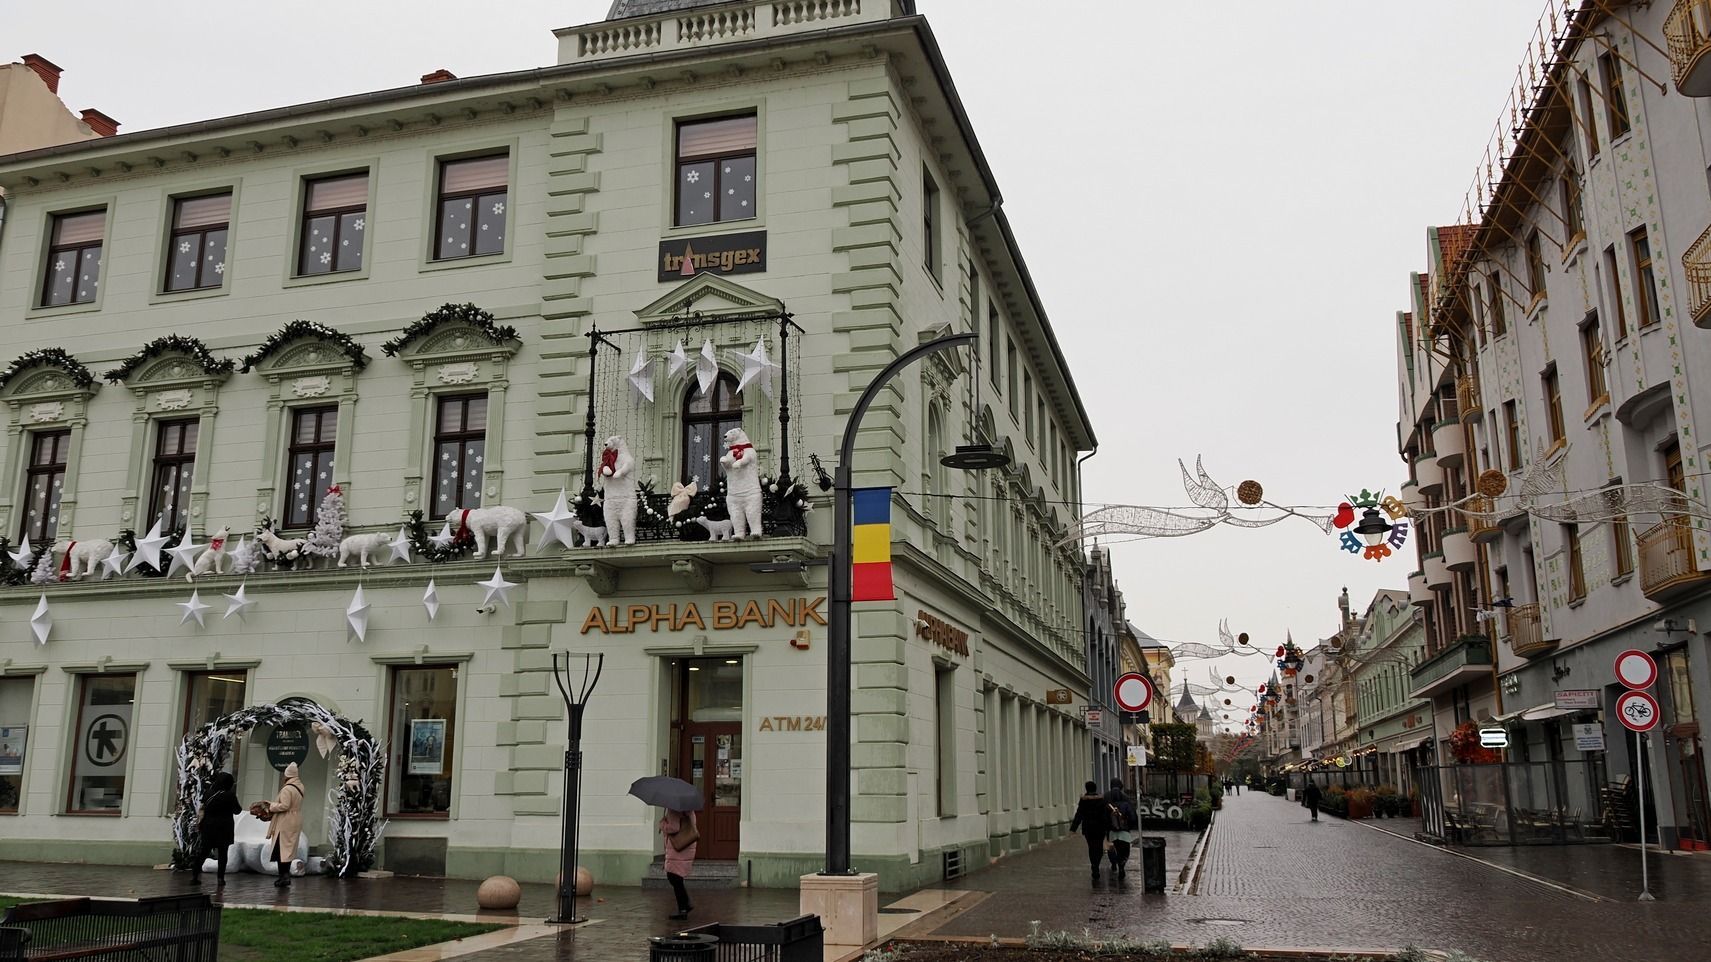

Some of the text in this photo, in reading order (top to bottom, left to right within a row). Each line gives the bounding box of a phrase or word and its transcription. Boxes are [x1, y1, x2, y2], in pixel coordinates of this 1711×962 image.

[580, 597, 828, 634] ALPHA BANK
[759, 716, 828, 732] ATM 24/
